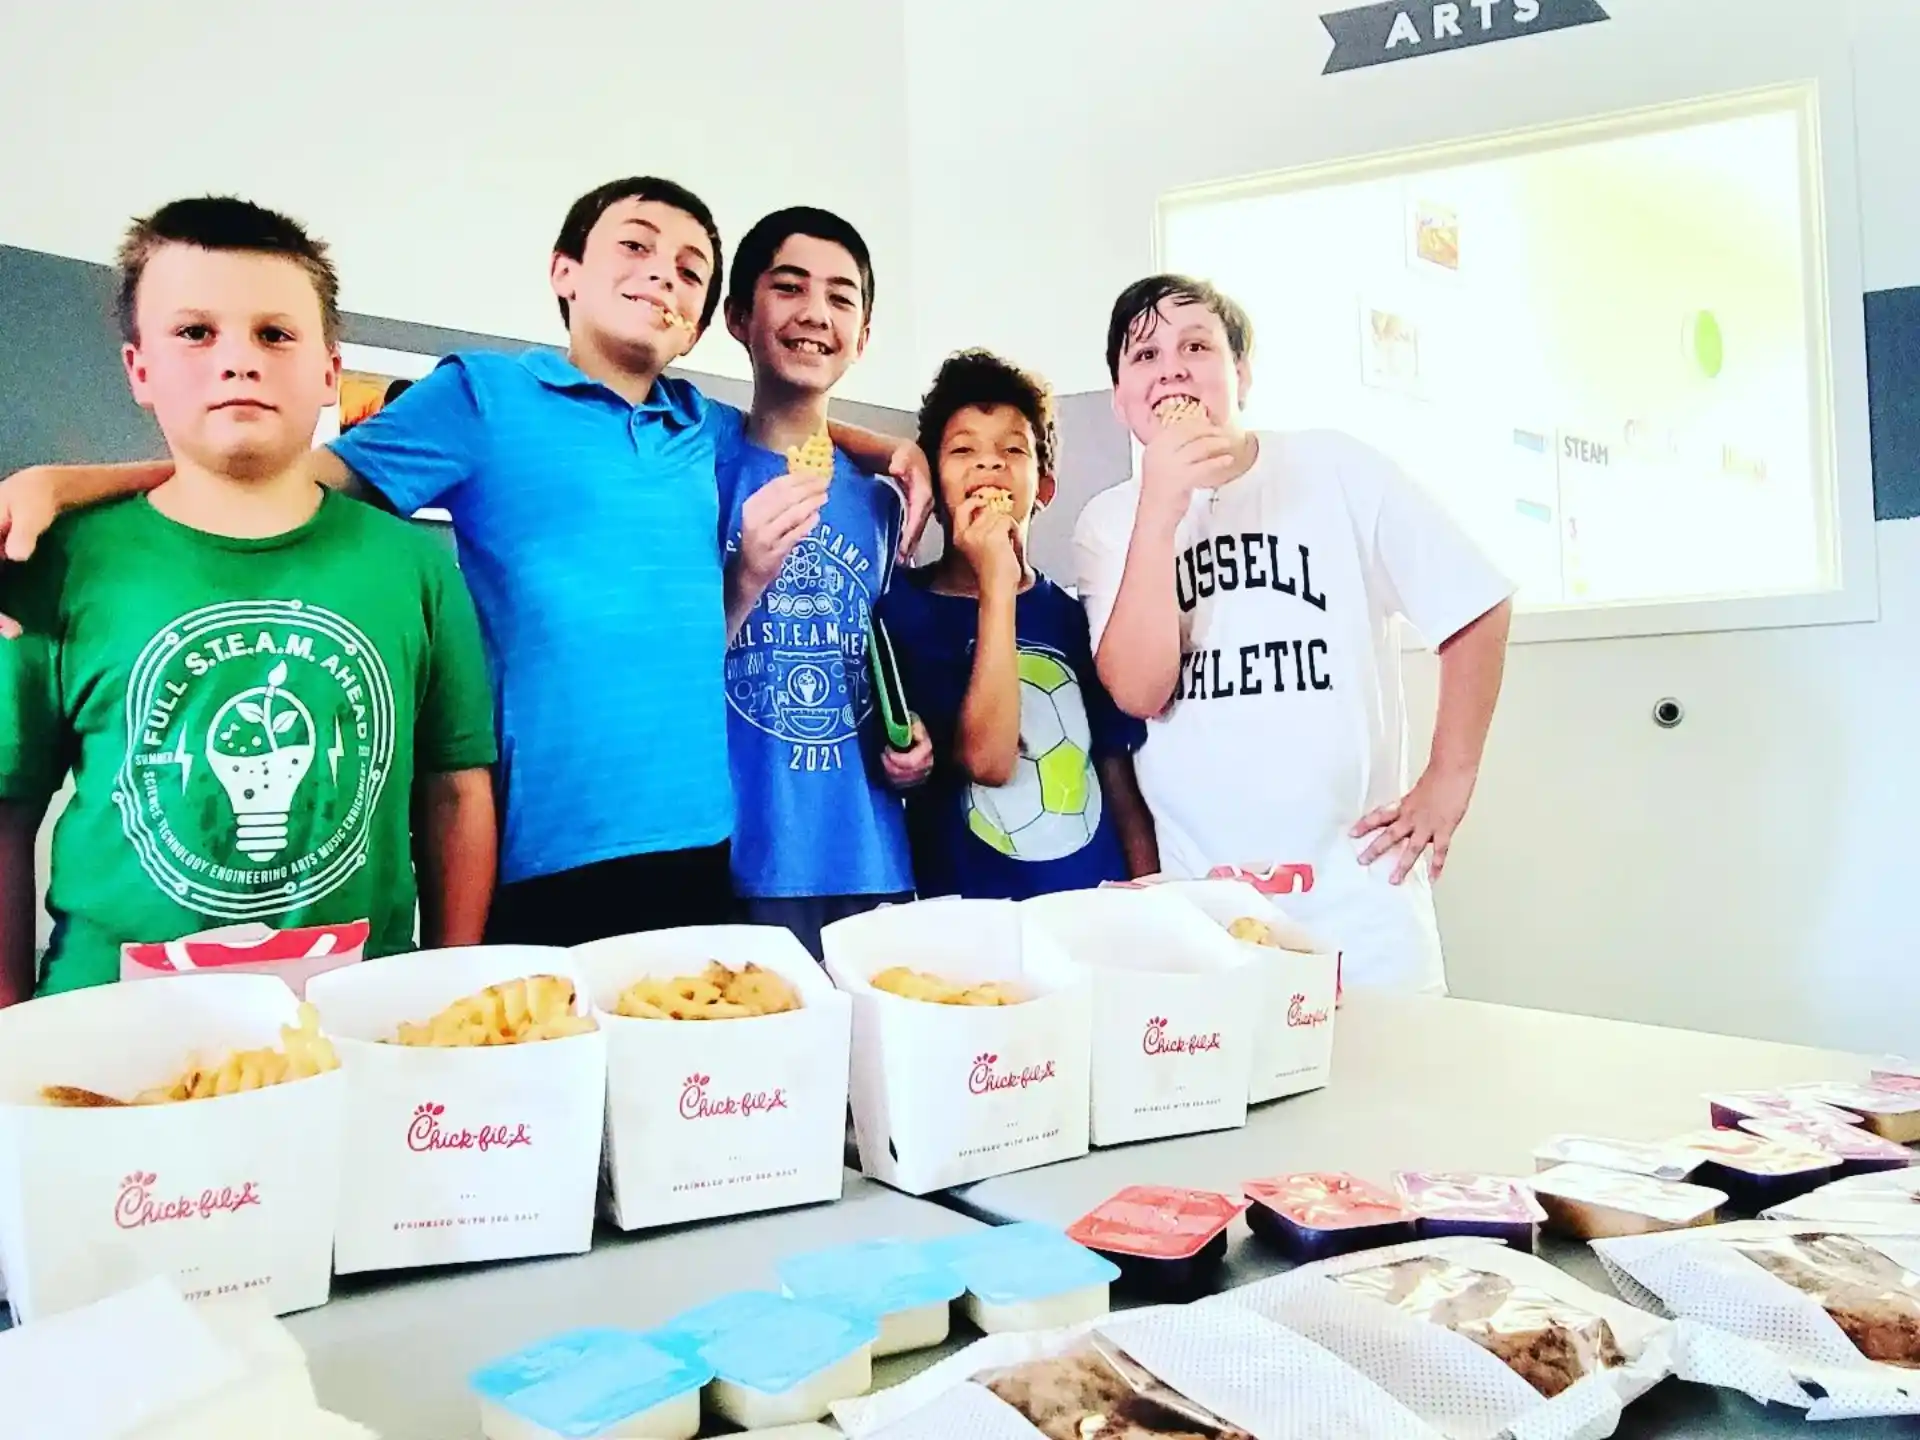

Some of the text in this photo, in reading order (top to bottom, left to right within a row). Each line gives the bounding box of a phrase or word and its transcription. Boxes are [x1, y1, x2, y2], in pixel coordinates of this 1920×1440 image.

[1384, 0, 1541, 49] ARTS
[1564, 436, 1609, 467] STEAM
[820, 523, 870, 572] CAMP
[1175, 532, 1327, 613] USSELL
[143, 631, 368, 746] FULL S.T.E.A.M. AHEAD
[789, 745, 842, 772] 2021
[142, 770, 160, 821] SCIENCE
[157, 817, 209, 874] TECHNOLOGY
[209, 863, 288, 885] ENGINEERING
[290, 853, 319, 875] ARTS
[318, 829, 347, 860] MUSIC
[1143, 1024, 1220, 1056] Chick-fil-A
[968, 1060, 1055, 1095] Chick-fil-A
[679, 1084, 787, 1120] Chick-fil-A
[407, 1113, 532, 1153] Chick-fil-A
[115, 1181, 261, 1230] Chick-fil-A
[393, 1218, 453, 1231] SPRINKLED
[457, 1215, 486, 1226] WITH
[217, 1284, 239, 1296] SEA
[244, 1275, 272, 1289] SALT
